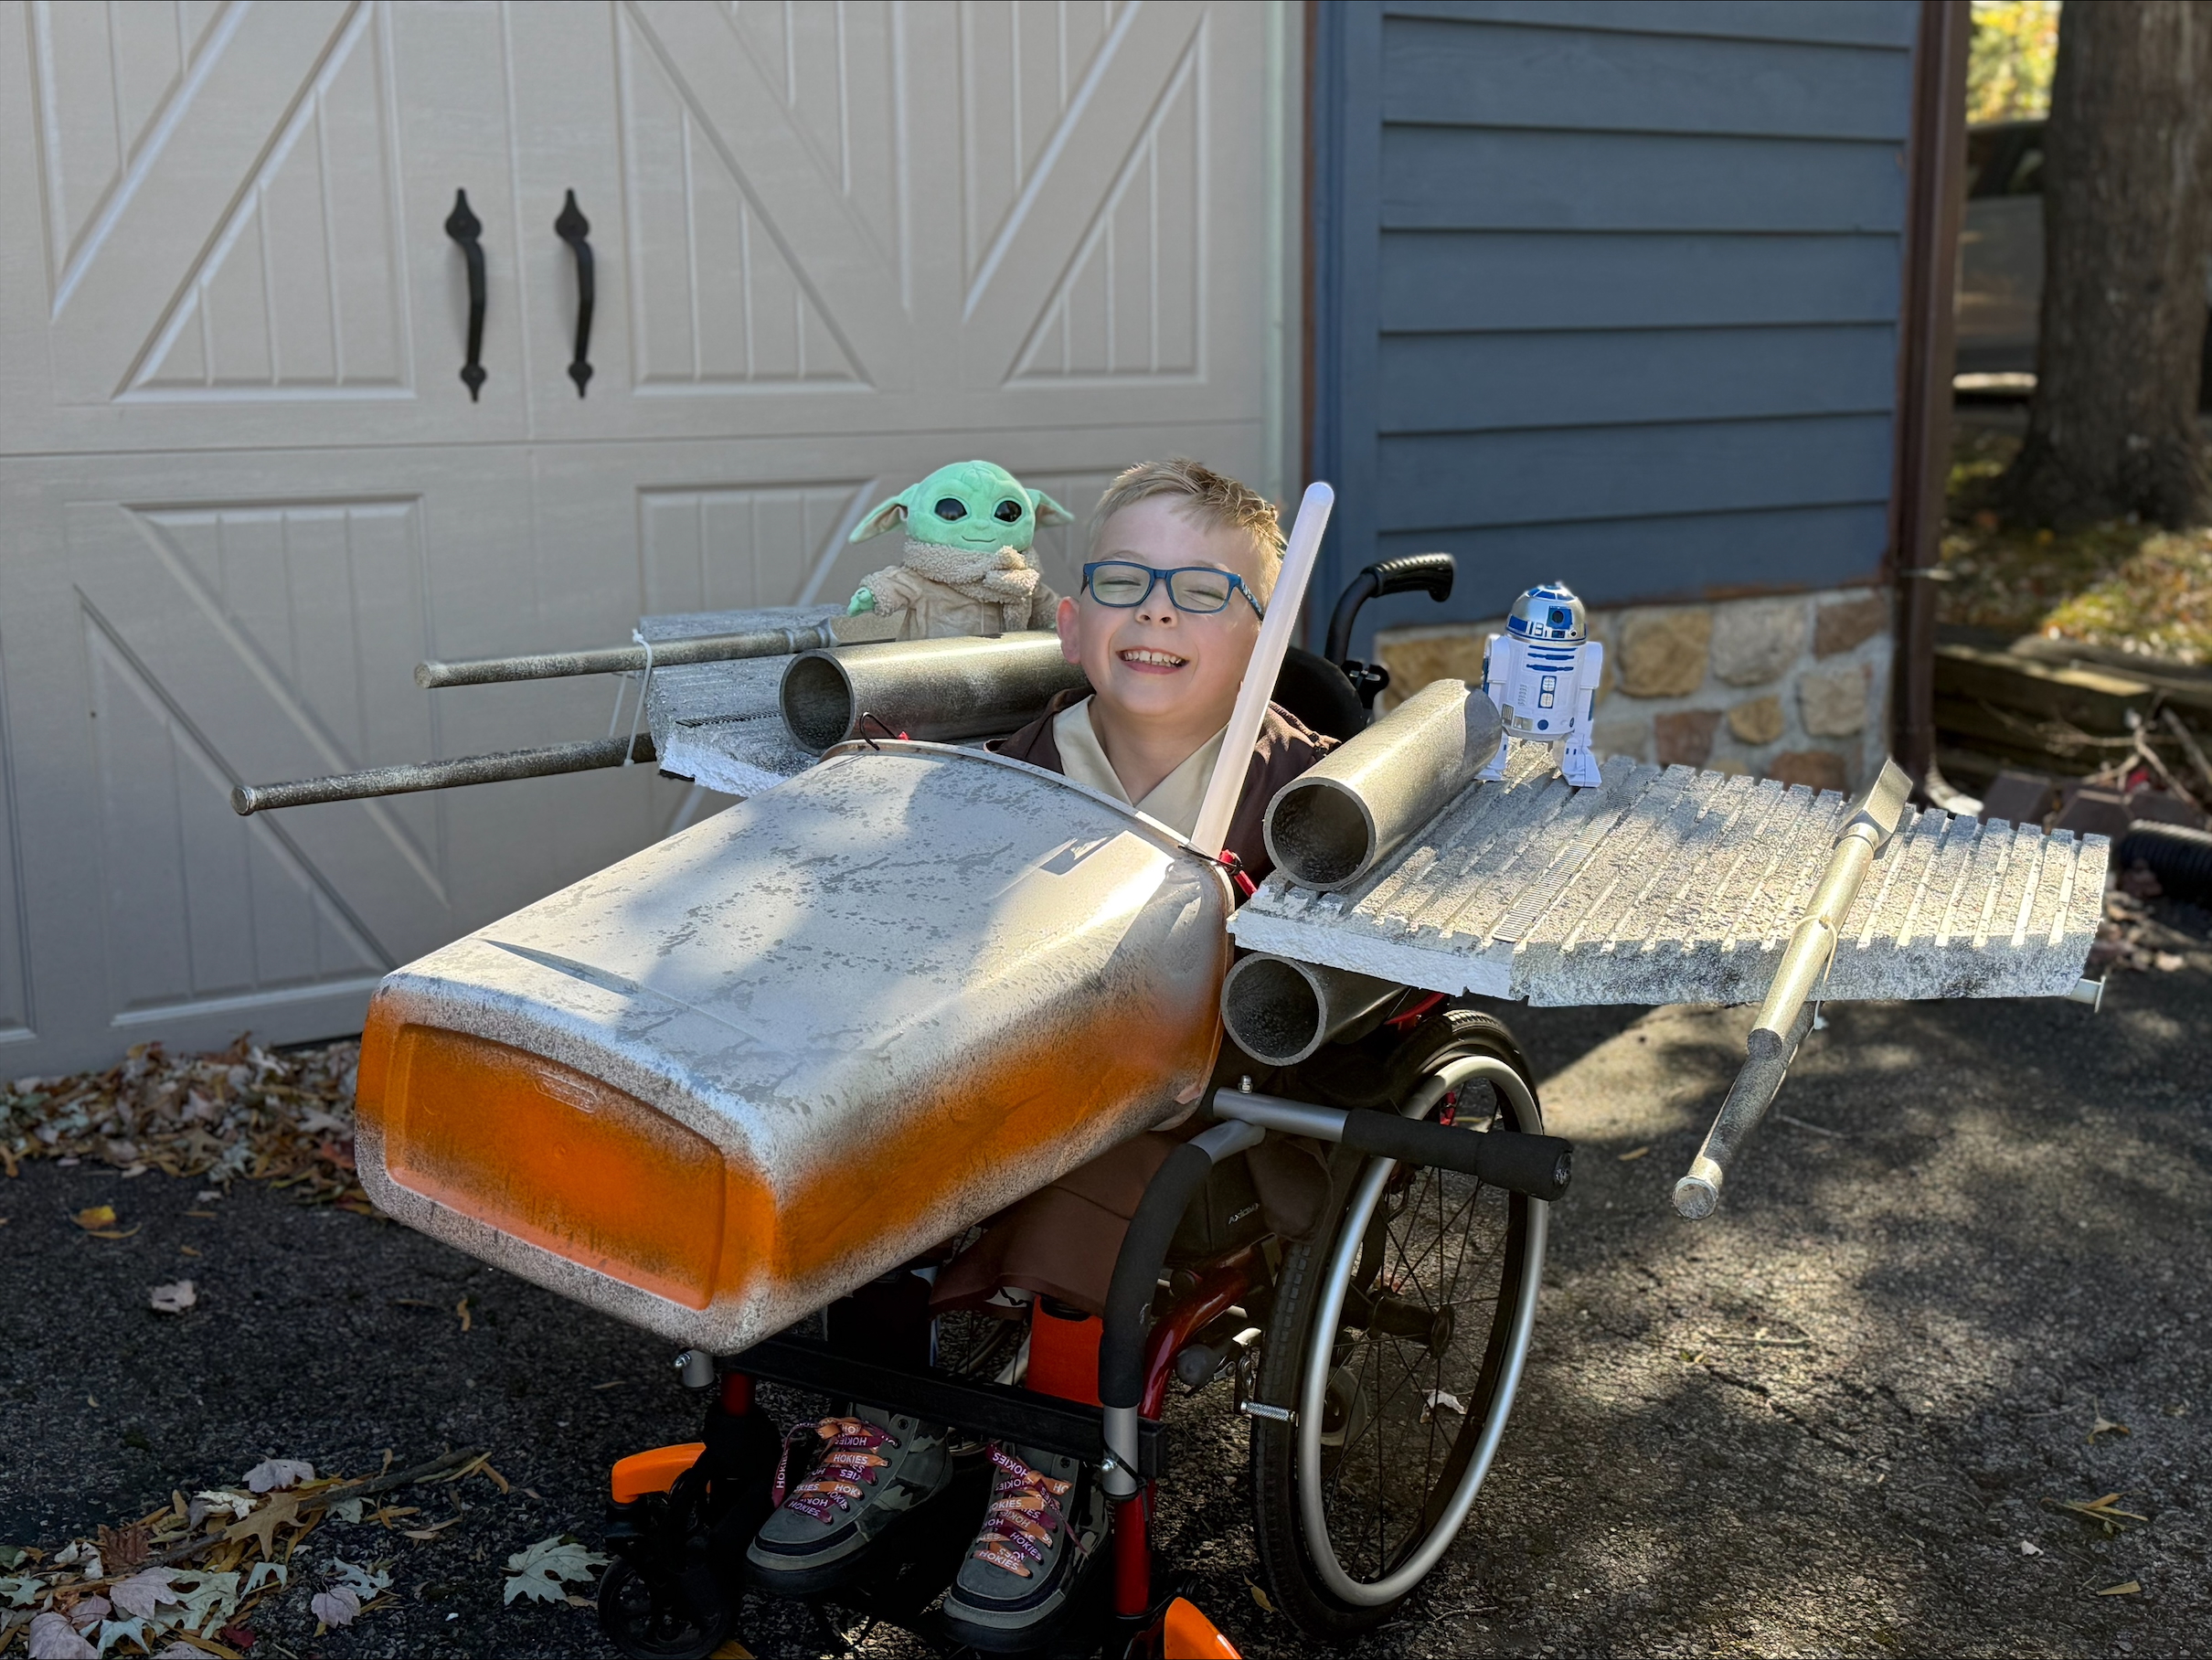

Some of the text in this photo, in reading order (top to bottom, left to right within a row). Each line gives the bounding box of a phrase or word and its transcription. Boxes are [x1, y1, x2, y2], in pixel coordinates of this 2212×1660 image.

[834, 1454, 868, 1464] HOKIES
[993, 1452, 1029, 1476] HOKIES
[788, 1501, 821, 1517] HOKIES
[979, 1551, 1019, 1570] HOKIES
